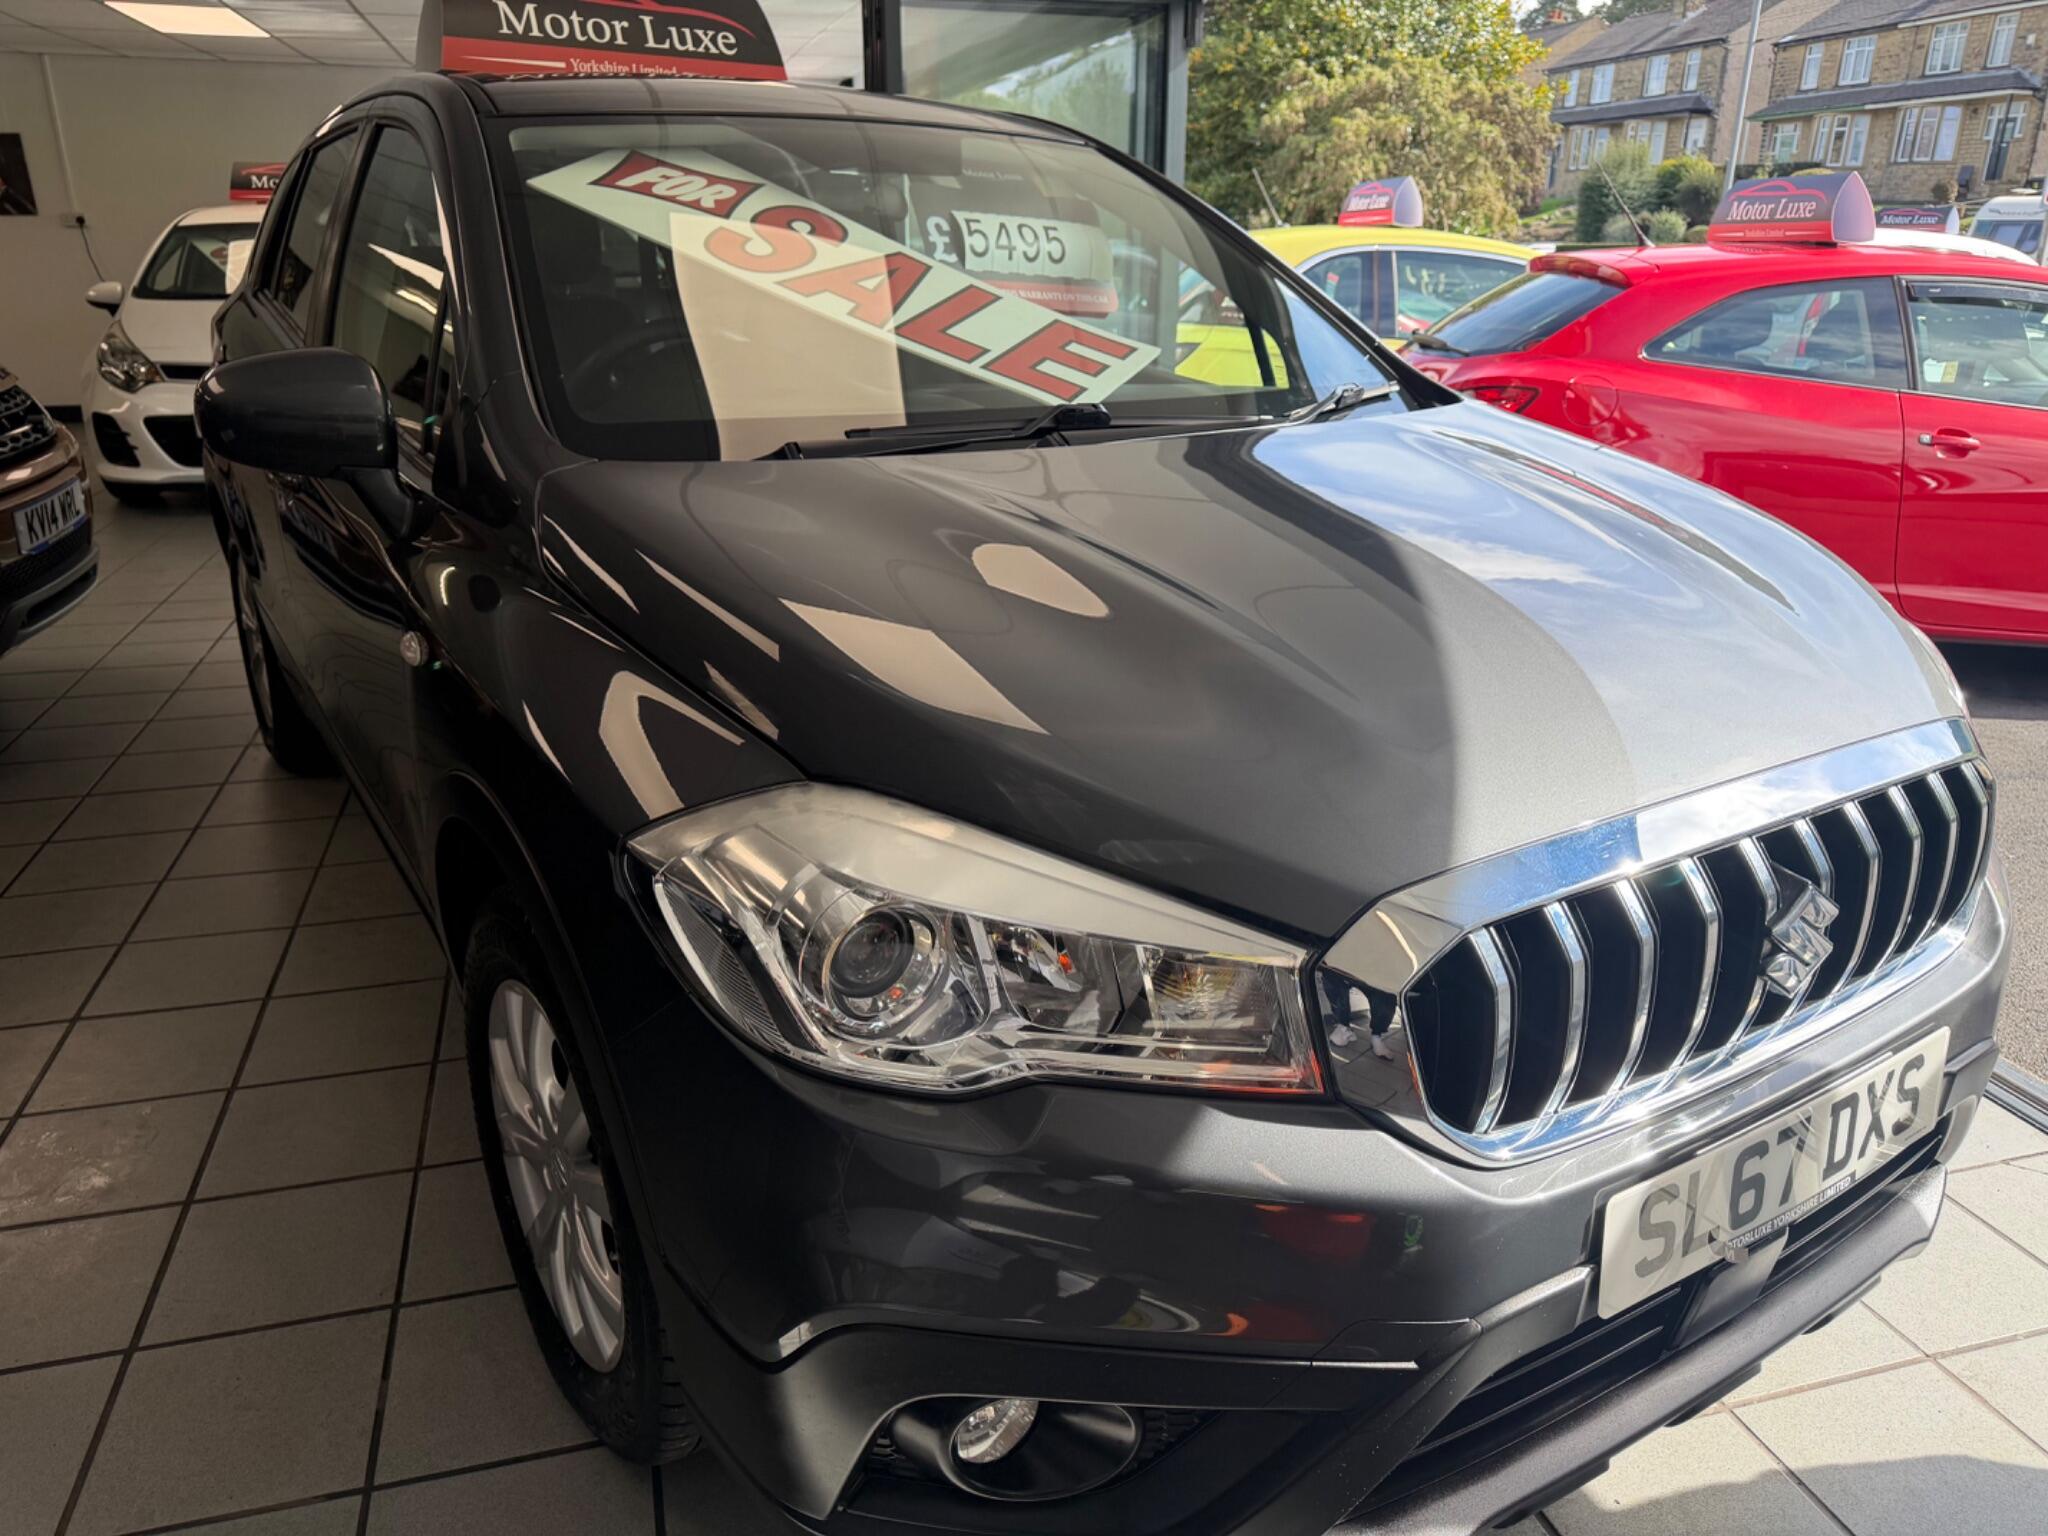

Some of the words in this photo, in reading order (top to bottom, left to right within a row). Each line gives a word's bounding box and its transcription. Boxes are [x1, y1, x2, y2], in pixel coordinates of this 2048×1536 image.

[497, 0, 629, 46] Motor
[639, 14, 738, 56] Luxe
[569, 58, 630, 73] Yorkshire
[1727, 200, 1775, 220] Motor
[1775, 198, 1817, 219] Luxe
[1881, 214, 1912, 224] Motor
[1912, 214, 1938, 225] Luxe
[614, 165, 739, 209] FOR
[703, 203, 1138, 404] SALE
[24, 499, 60, 545] KV14
[1822, 1053, 1925, 1182] DXS
[1773, 1196, 1819, 1228] YORKSHIRE
[1819, 1175, 1852, 1204] LIMITED
